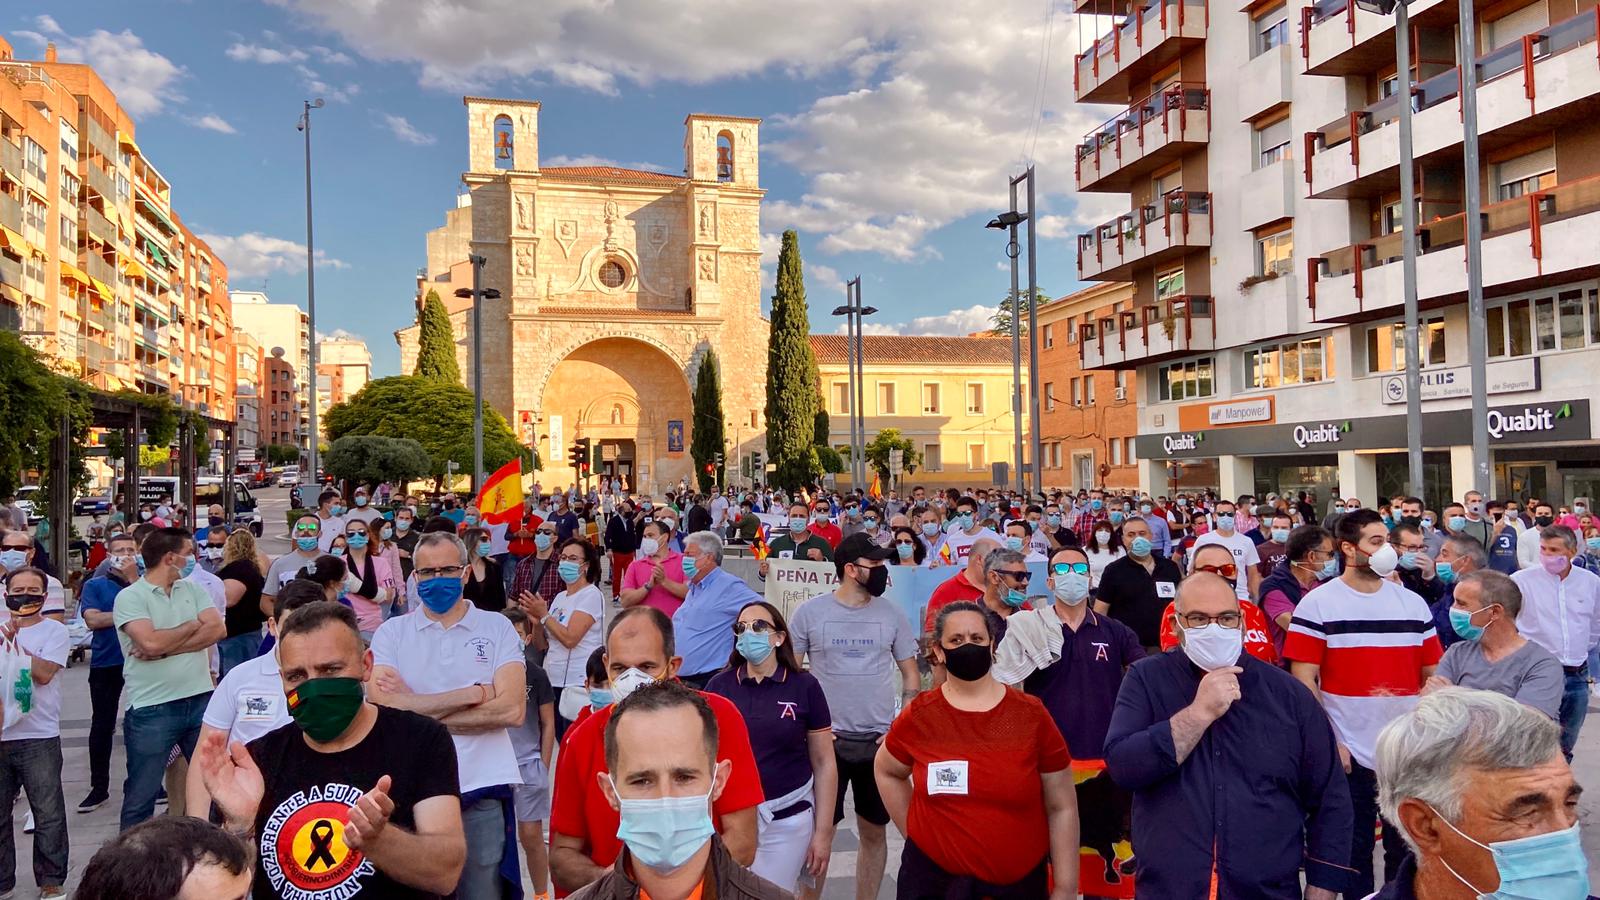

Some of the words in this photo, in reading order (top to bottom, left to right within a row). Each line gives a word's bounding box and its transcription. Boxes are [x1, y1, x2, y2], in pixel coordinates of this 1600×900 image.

[1420, 372, 1455, 387] ALUS
[1491, 383, 1501, 391] de
[1502, 380, 1530, 390] Seguros
[1225, 404, 1265, 420] Manpower
[1487, 407, 1554, 439] Quabit
[1163, 433, 1197, 455] Quabit
[1293, 423, 1341, 449] Quabit
[1499, 536, 1511, 549] 3
[776, 567, 819, 584] PEÑA
[261, 791, 308, 856] FRENTE
